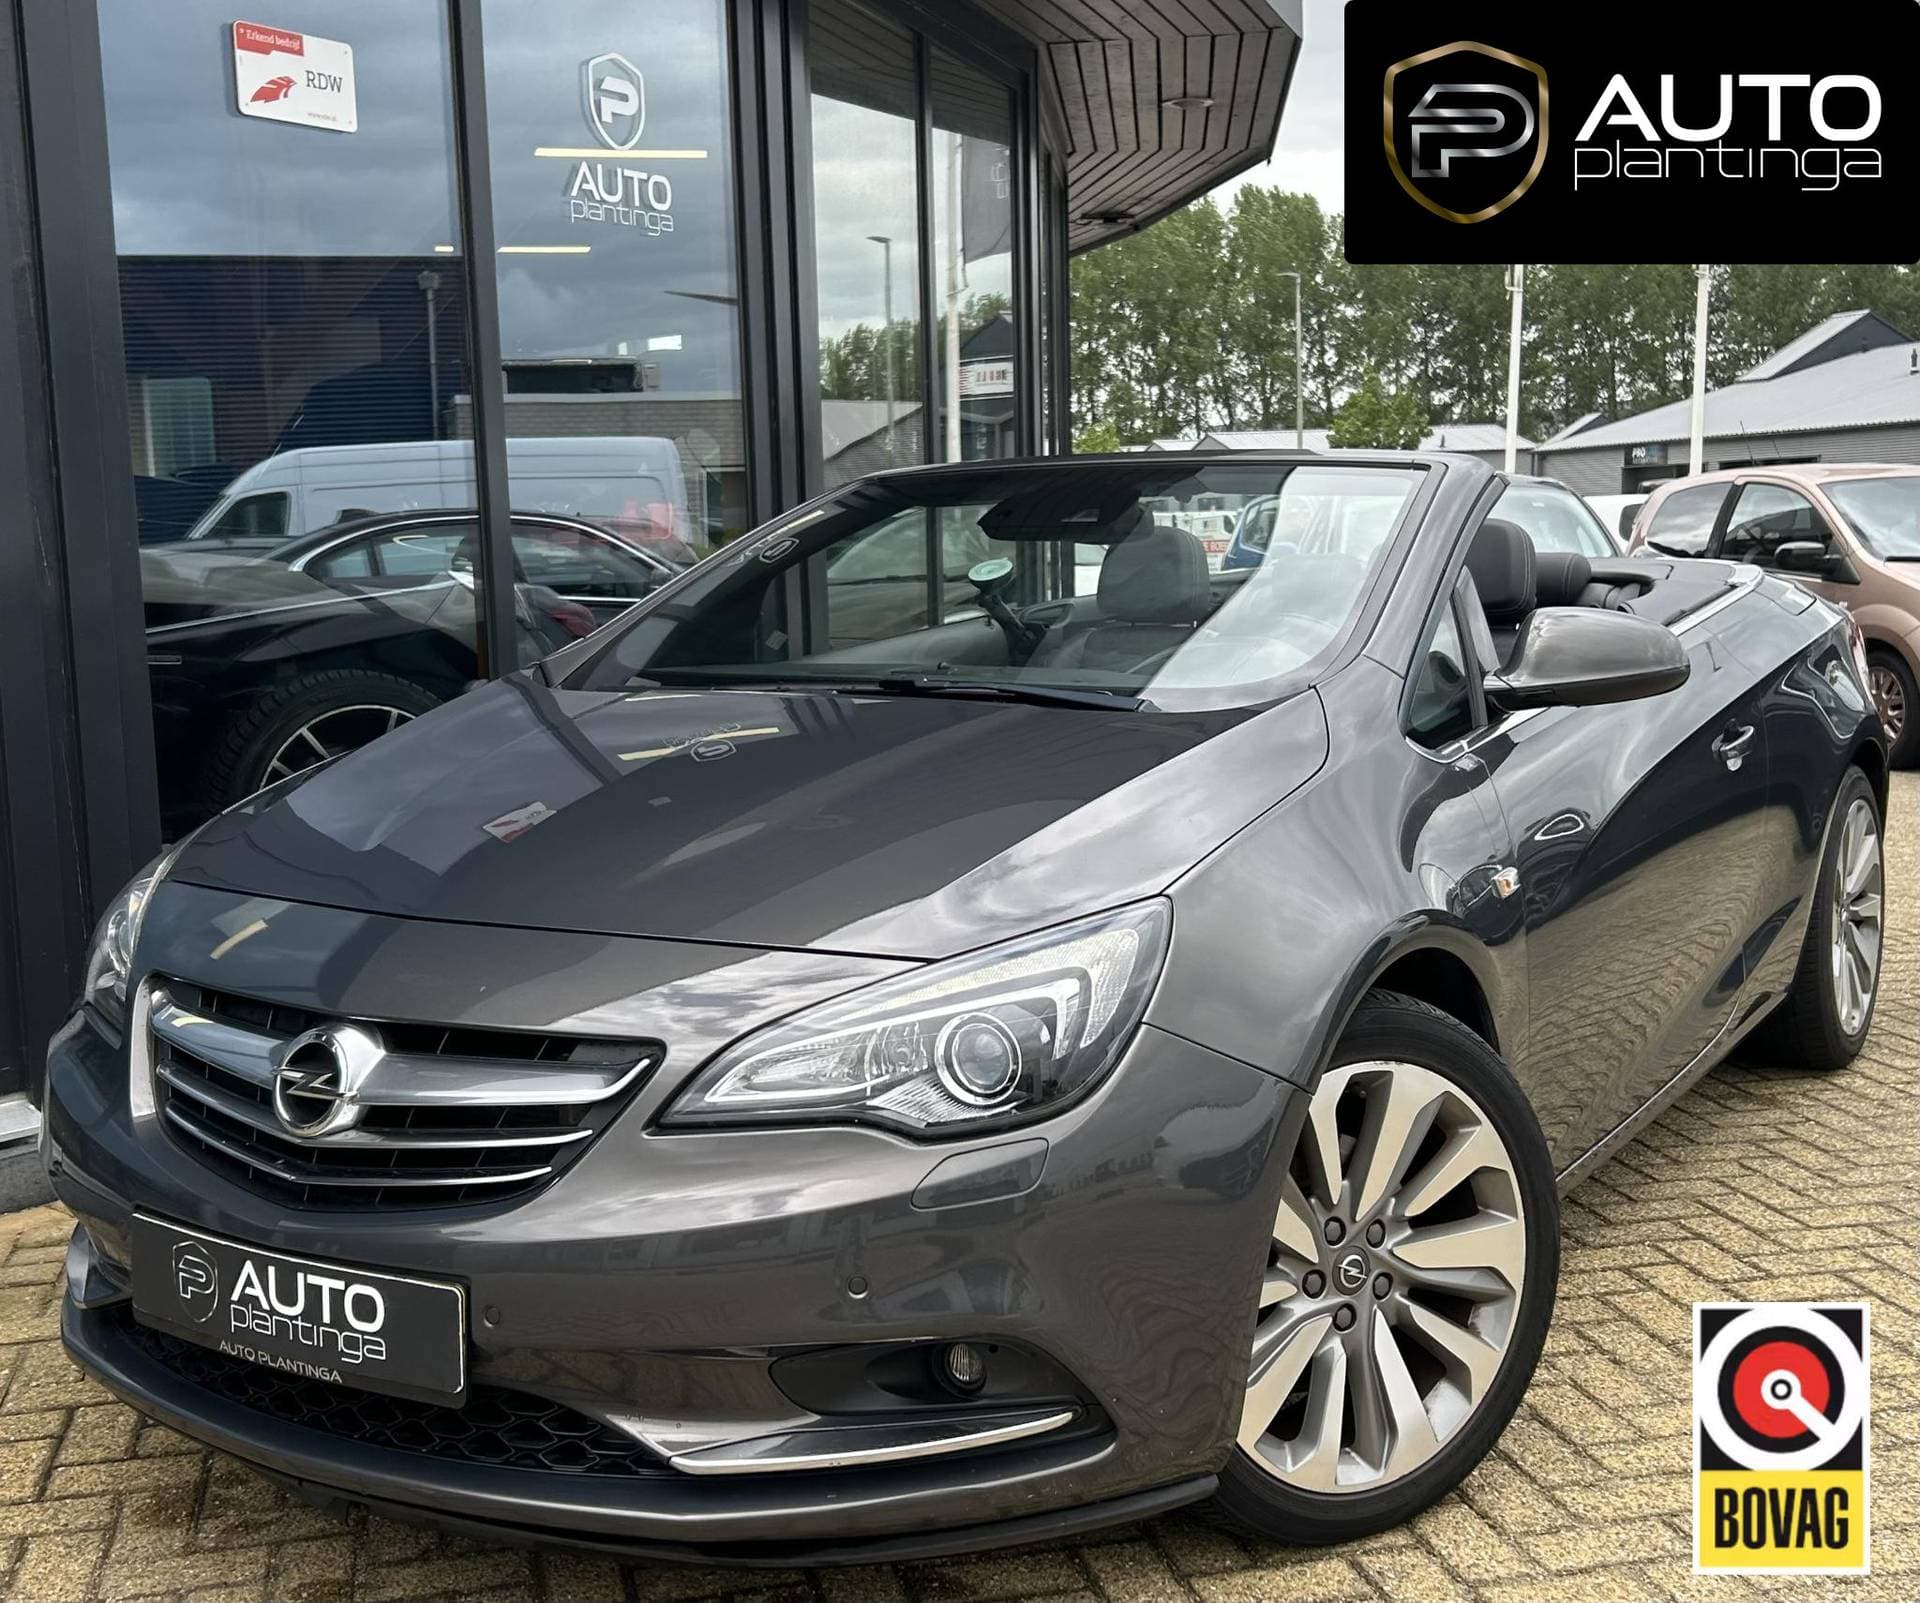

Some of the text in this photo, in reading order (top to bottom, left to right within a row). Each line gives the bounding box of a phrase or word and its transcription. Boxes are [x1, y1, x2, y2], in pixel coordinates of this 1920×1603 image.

[246, 29, 274, 44] Erkend
[305, 70, 343, 93] RDW
[571, 160, 672, 211] AUTO
[571, 198, 674, 237] plantinga
[231, 1260, 385, 1333] AUTO
[231, 1303, 386, 1364] plantinga
[219, 1339, 343, 1384] AUTO PLANTINGA
